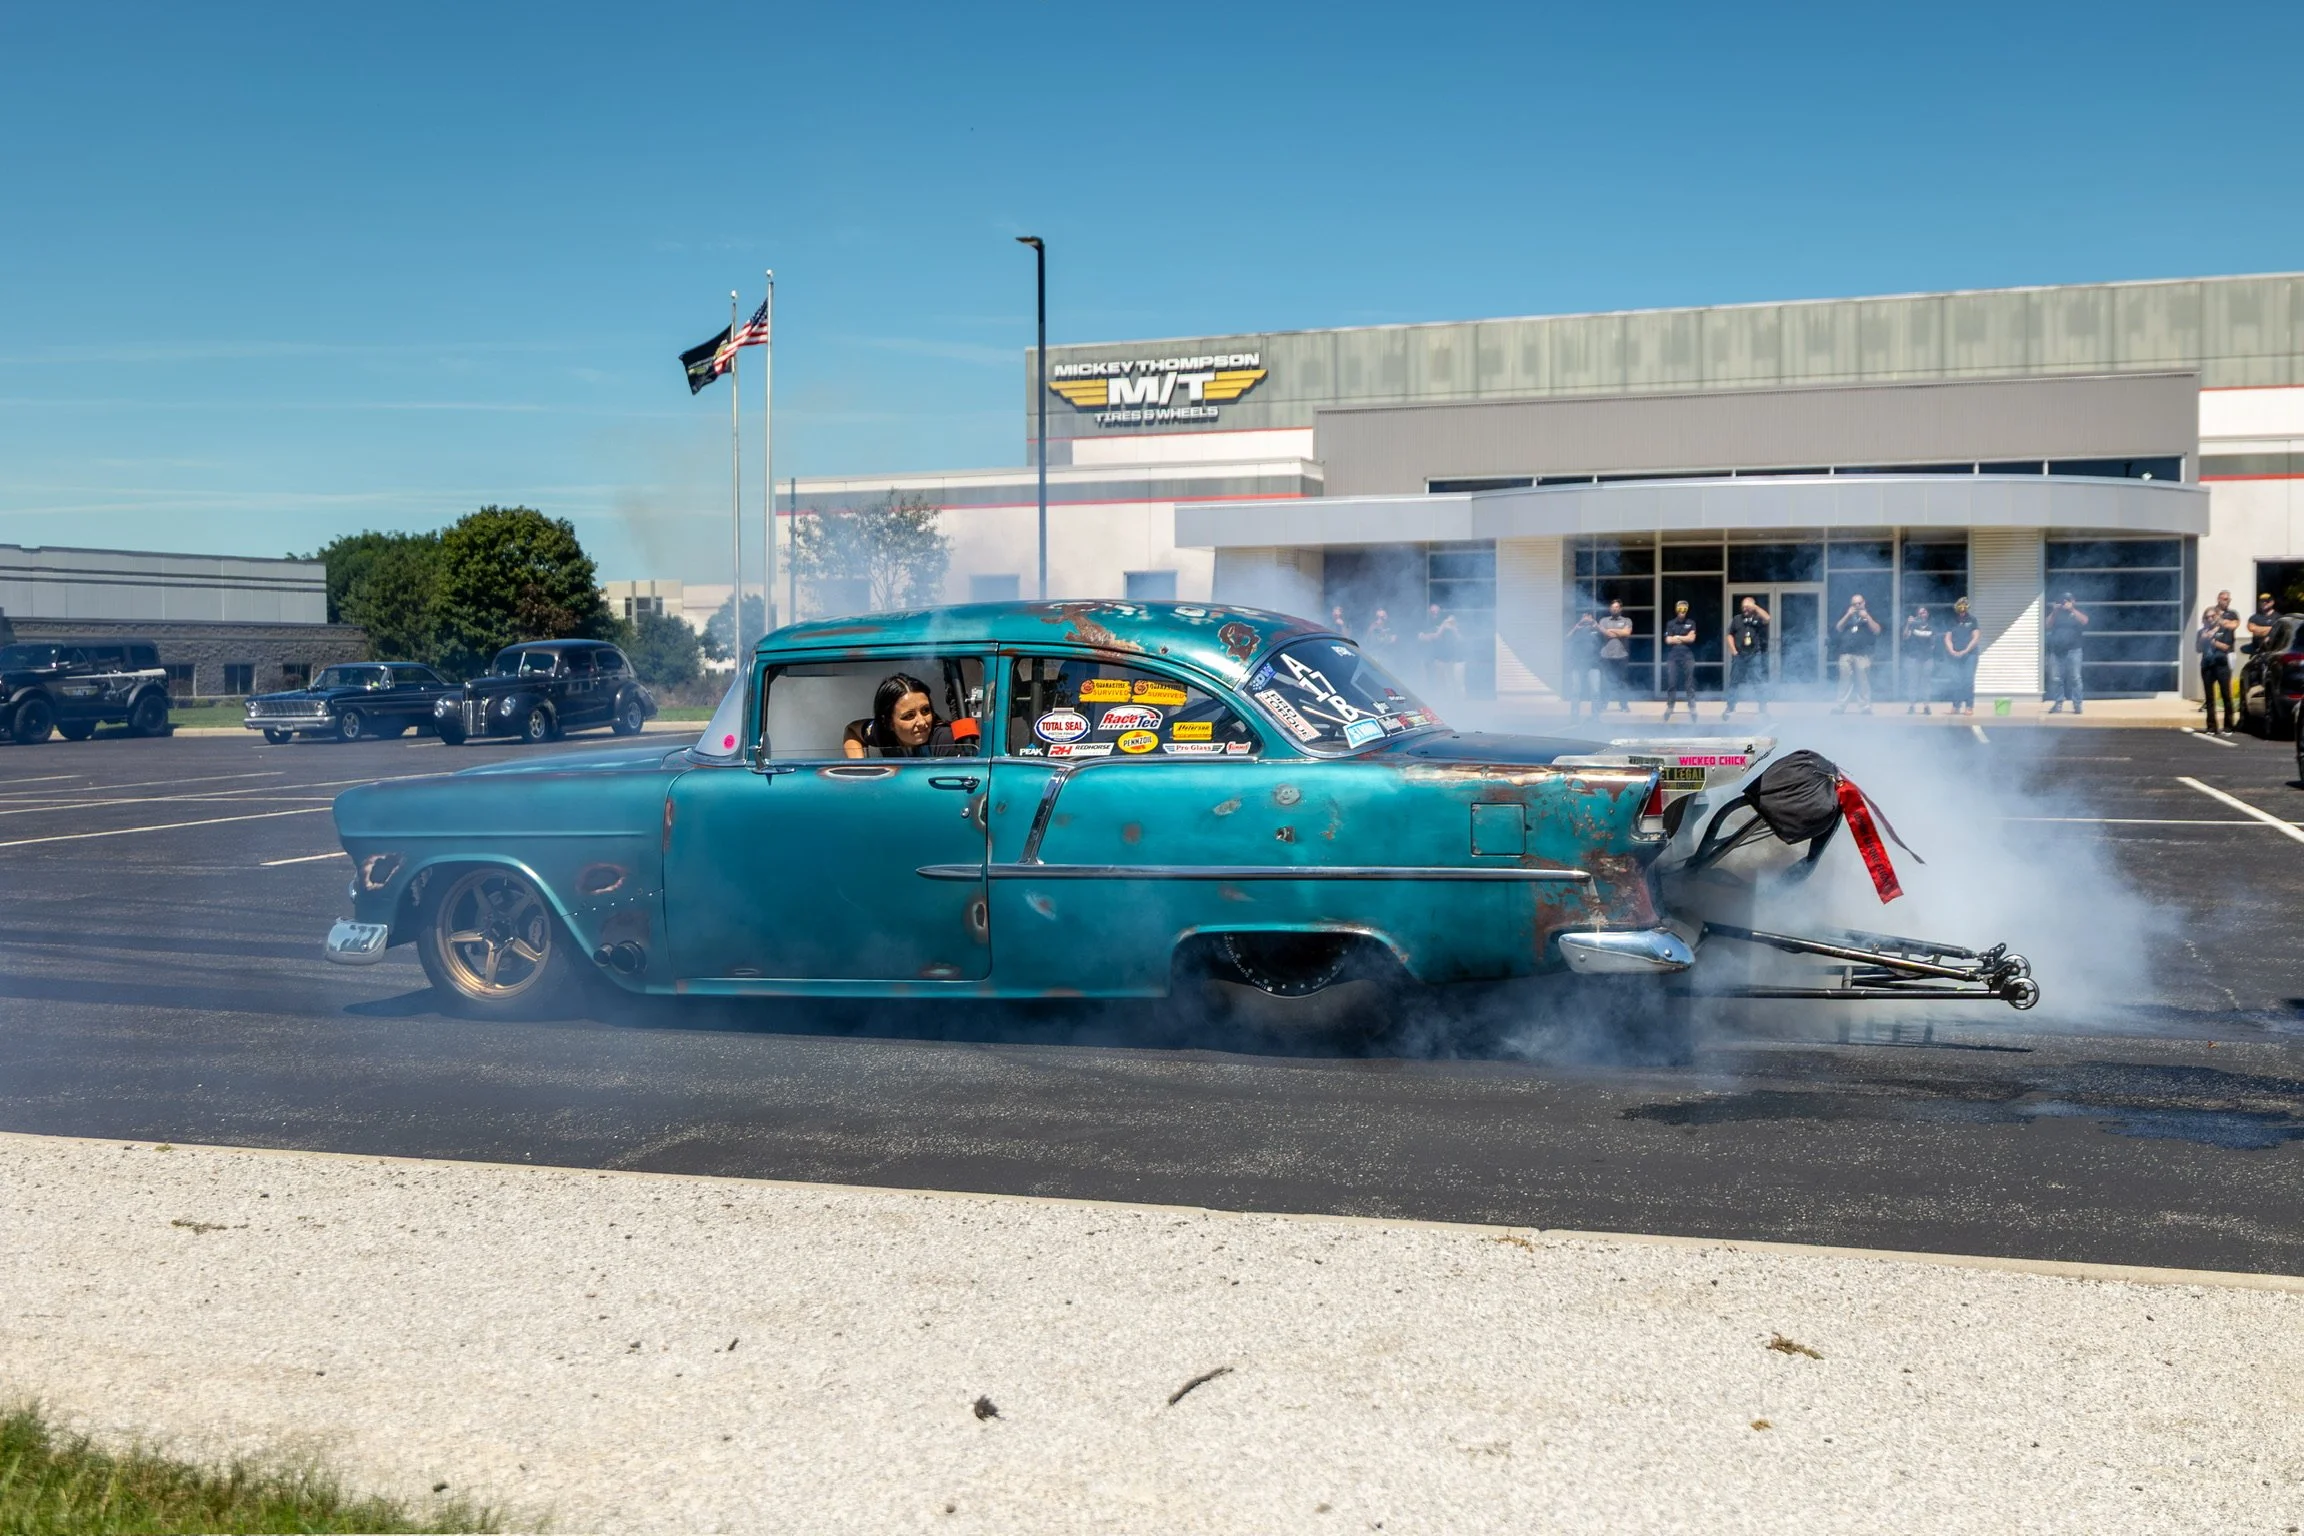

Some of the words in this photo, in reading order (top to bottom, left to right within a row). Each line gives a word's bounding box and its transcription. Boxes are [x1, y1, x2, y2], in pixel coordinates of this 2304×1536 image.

[1054, 361, 1135, 376] MICKEY
[1135, 352, 1260, 372] THOMPSON
[1108, 372, 1215, 406] M/T
[1095, 410, 1142, 423] TIRES
[1154, 406, 1219, 420] WHEELS
[1147, 691, 1184, 699] SURVIVED
[1270, 693, 1297, 718] PRO
[1264, 693, 1312, 738] TORQUE
[1041, 721, 1063, 731] TOTAL
[1065, 721, 1084, 731] SEAL
[1123, 735, 1152, 747] PENNZOIL
[1019, 748, 1044, 756] PEAK
[1678, 756, 1716, 766] WICKED
[1718, 755, 1747, 766] CHICK
[1673, 767, 1705, 780] LEGAL
